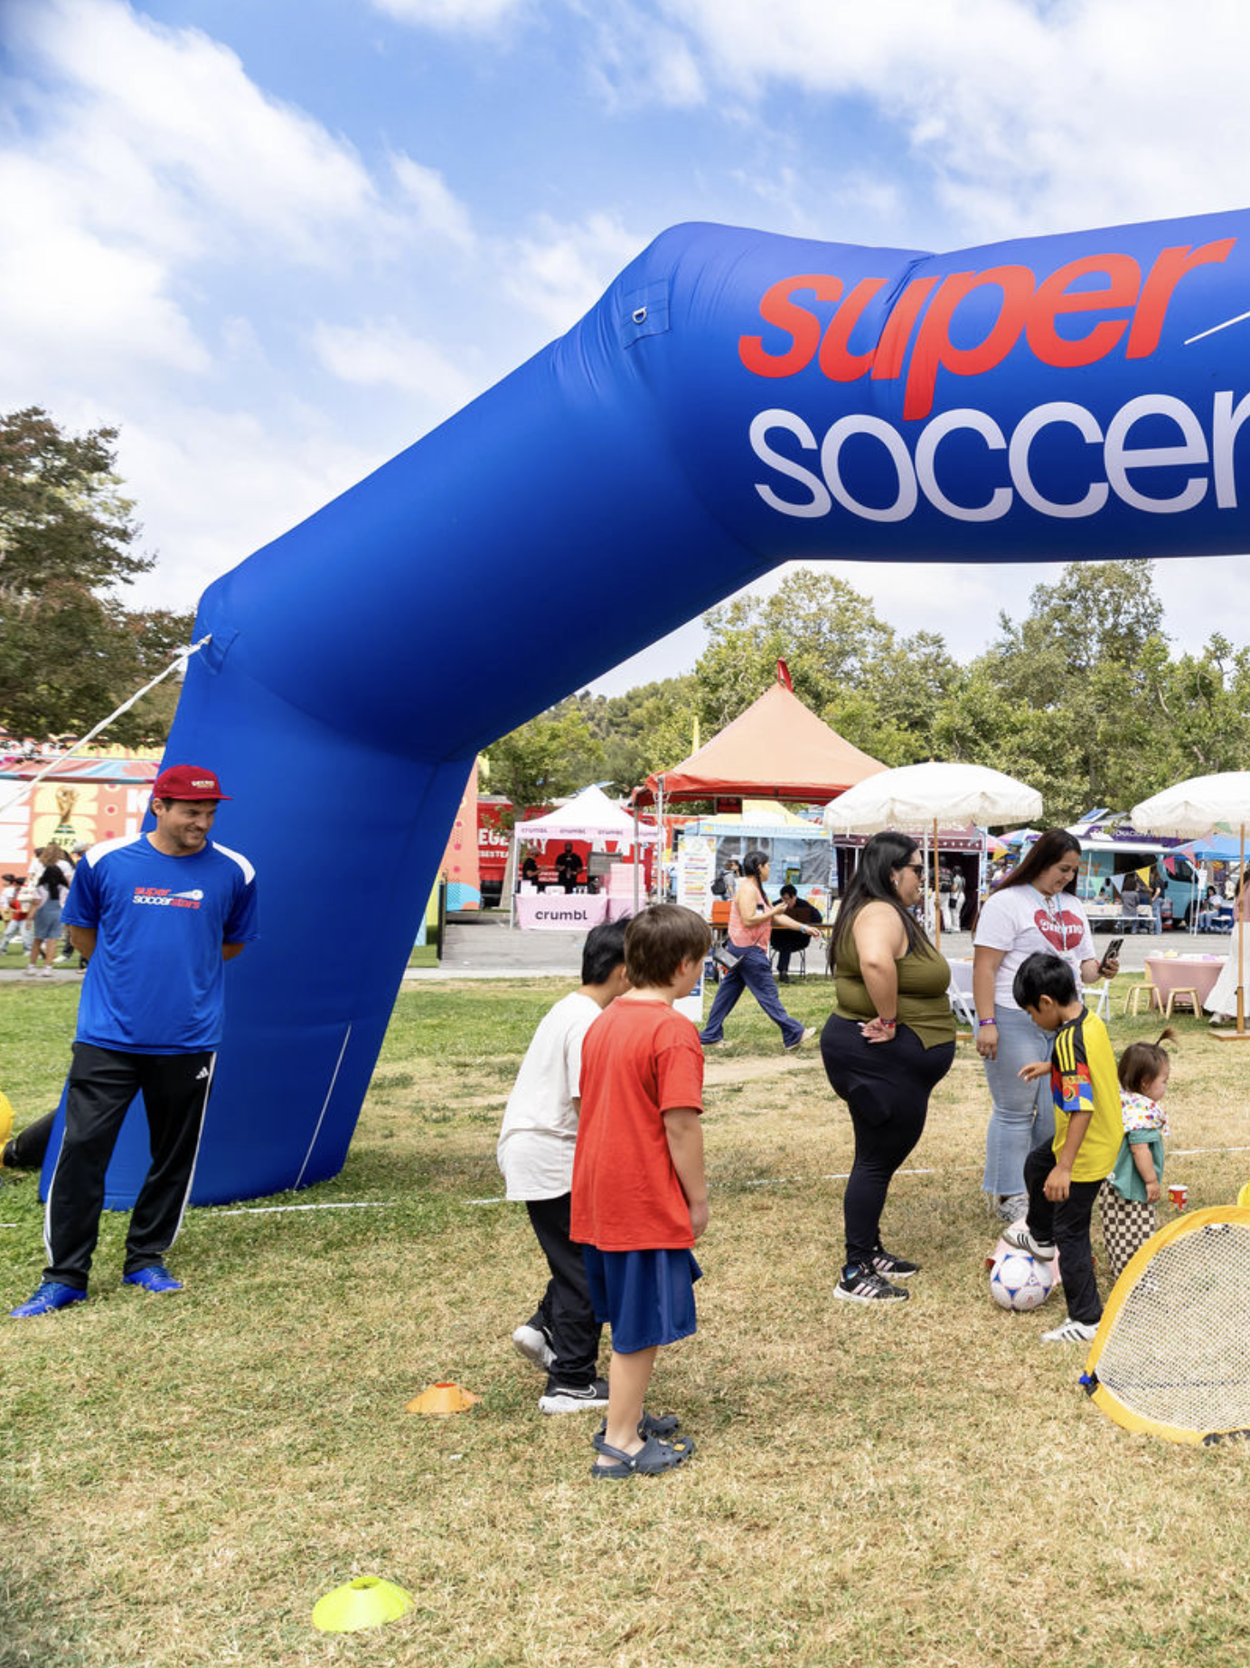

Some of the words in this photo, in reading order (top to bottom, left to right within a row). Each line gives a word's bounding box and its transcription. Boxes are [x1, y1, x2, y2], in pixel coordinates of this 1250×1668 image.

[738, 237, 1237, 421] super
[134, 887, 172, 897] super
[535, 909, 588, 921] crumbl
